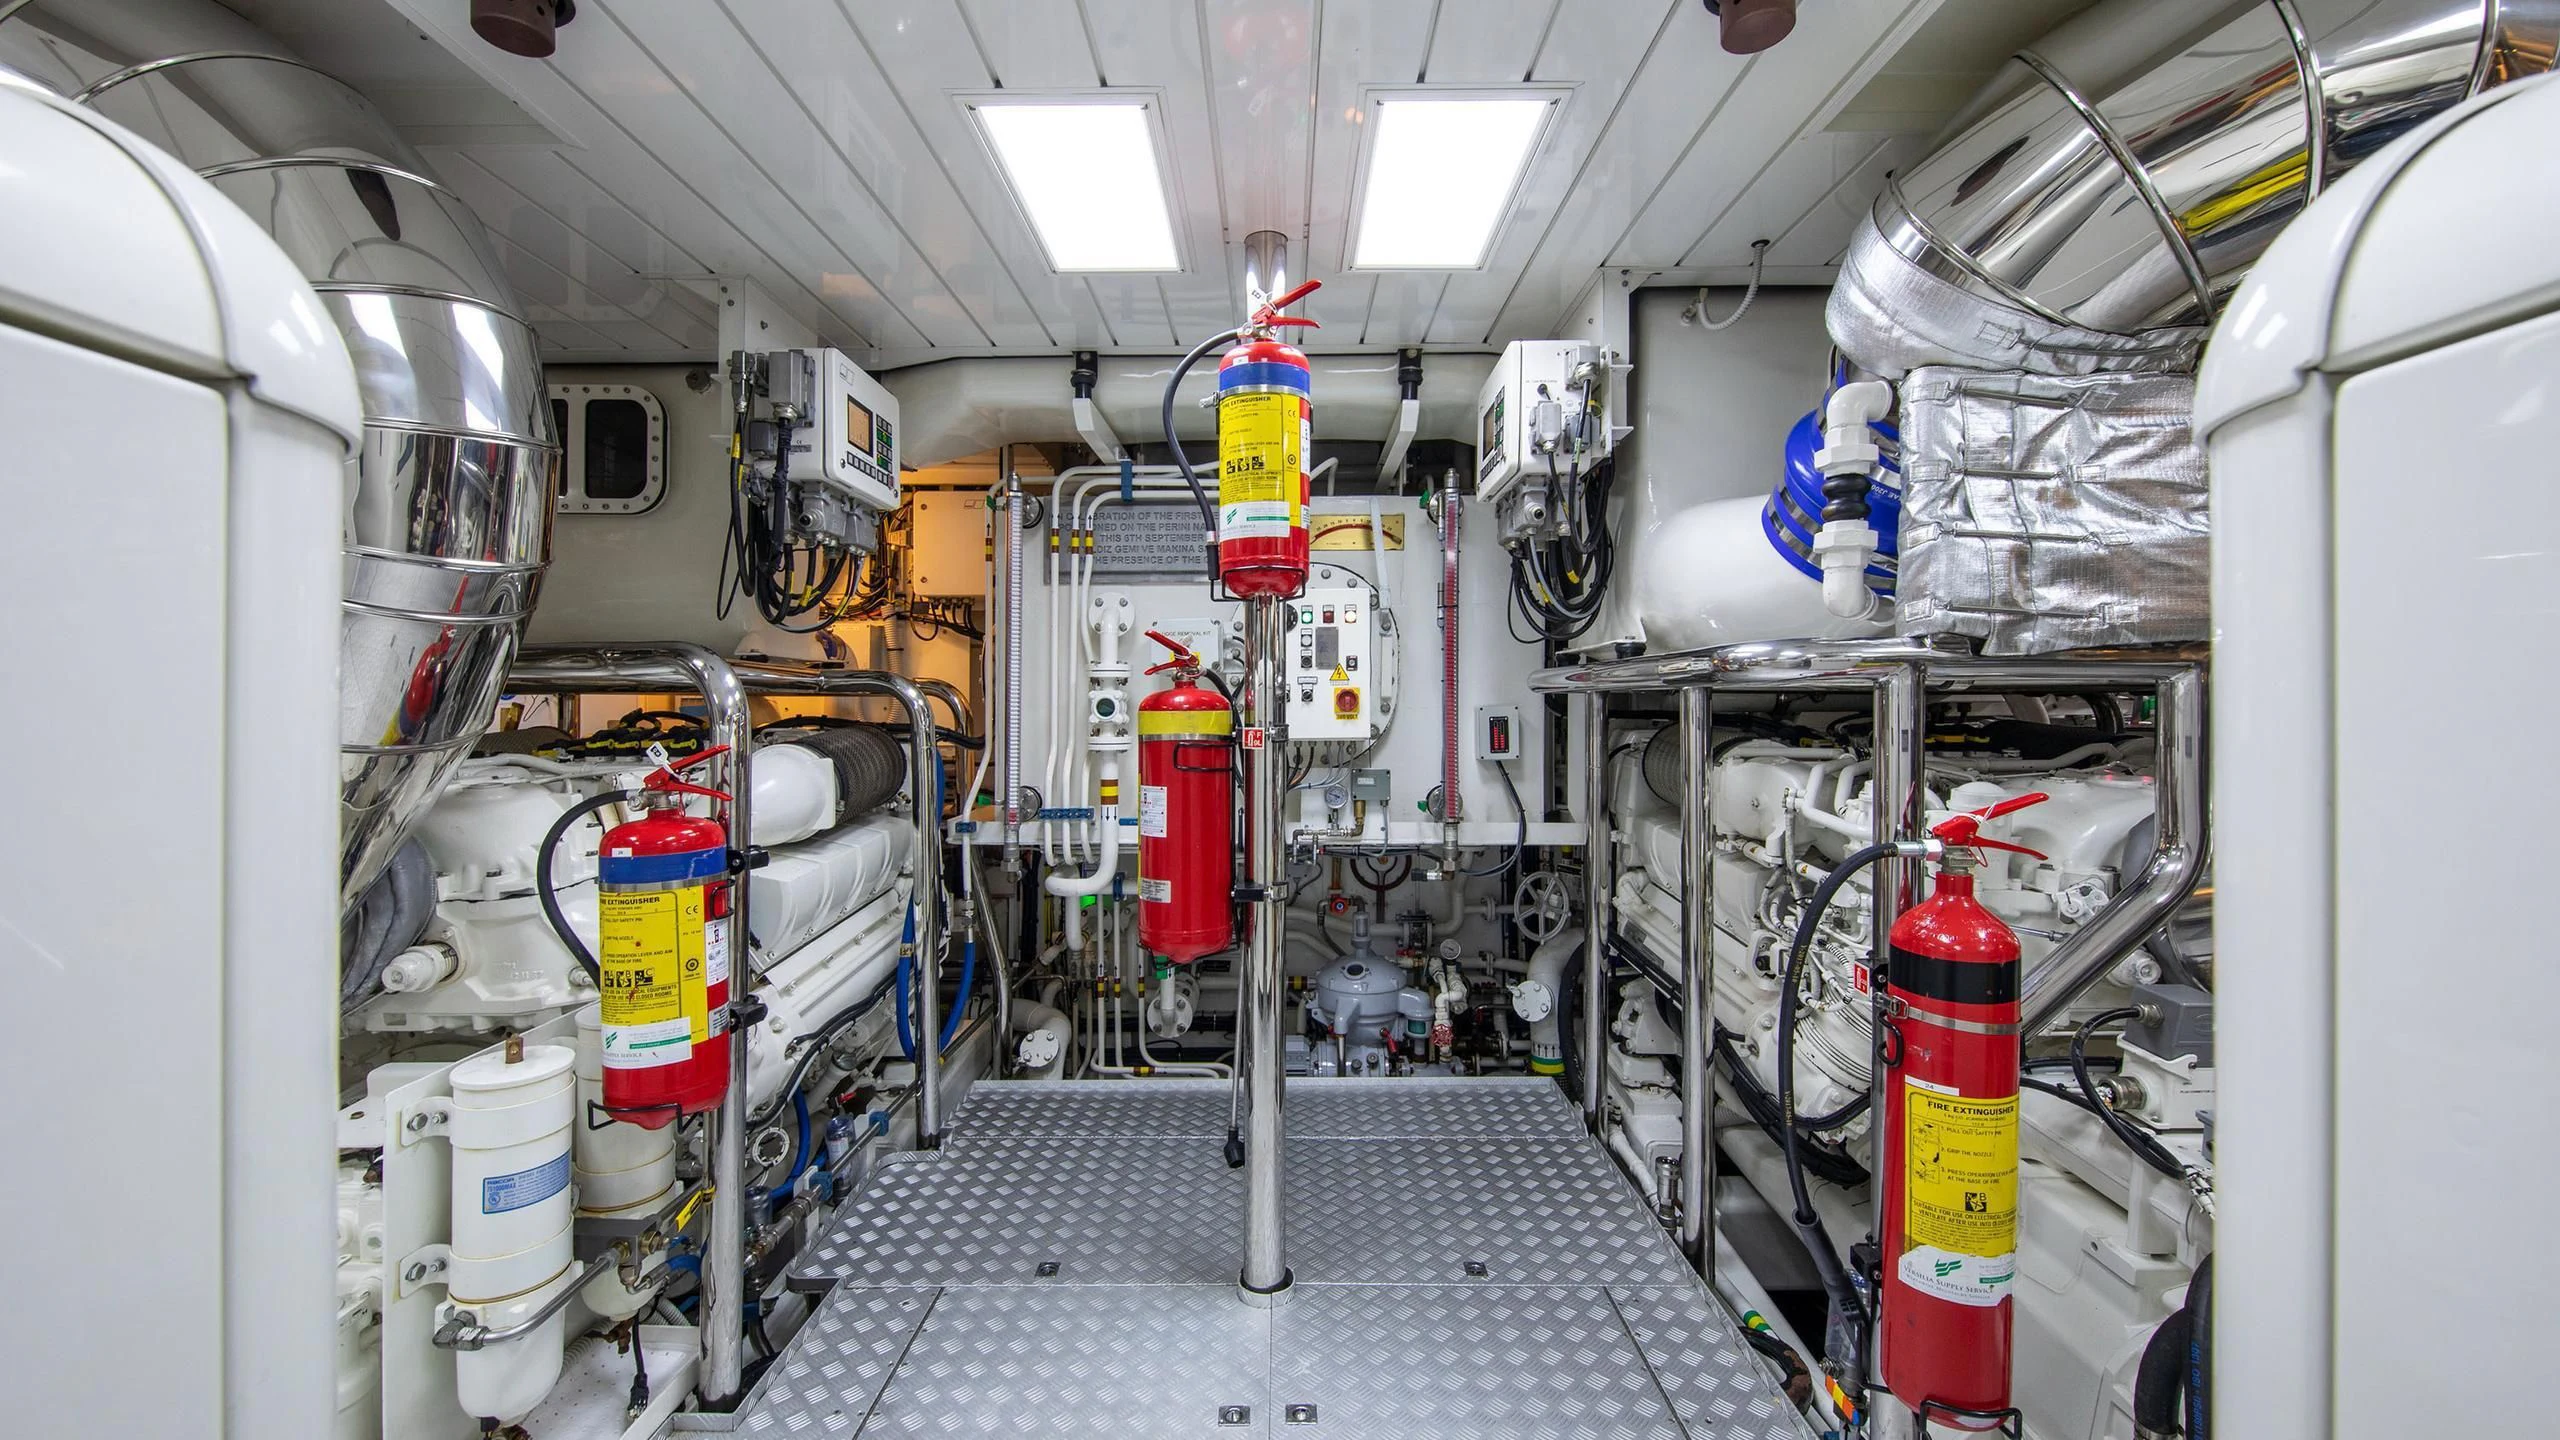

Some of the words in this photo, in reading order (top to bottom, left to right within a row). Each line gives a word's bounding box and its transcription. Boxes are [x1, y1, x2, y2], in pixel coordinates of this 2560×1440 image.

[1231, 396, 1271, 406] EXTINGUISHER
[1137, 512, 1150, 520] OF
[1153, 512, 1173, 520] THE
[1120, 523, 1134, 531] ON
[1100, 534, 1121, 542] THIS
[1111, 556, 1163, 564] PRESENCE
[608, 897, 660, 905] EXTINGUISHER
[1928, 1101, 1950, 1111] FIRE
[1954, 1105, 2014, 1116] EXTINGUISHER
[1914, 1200, 1936, 1211] SUITABLE
[1936, 1280, 1963, 1291] SUPPLY
